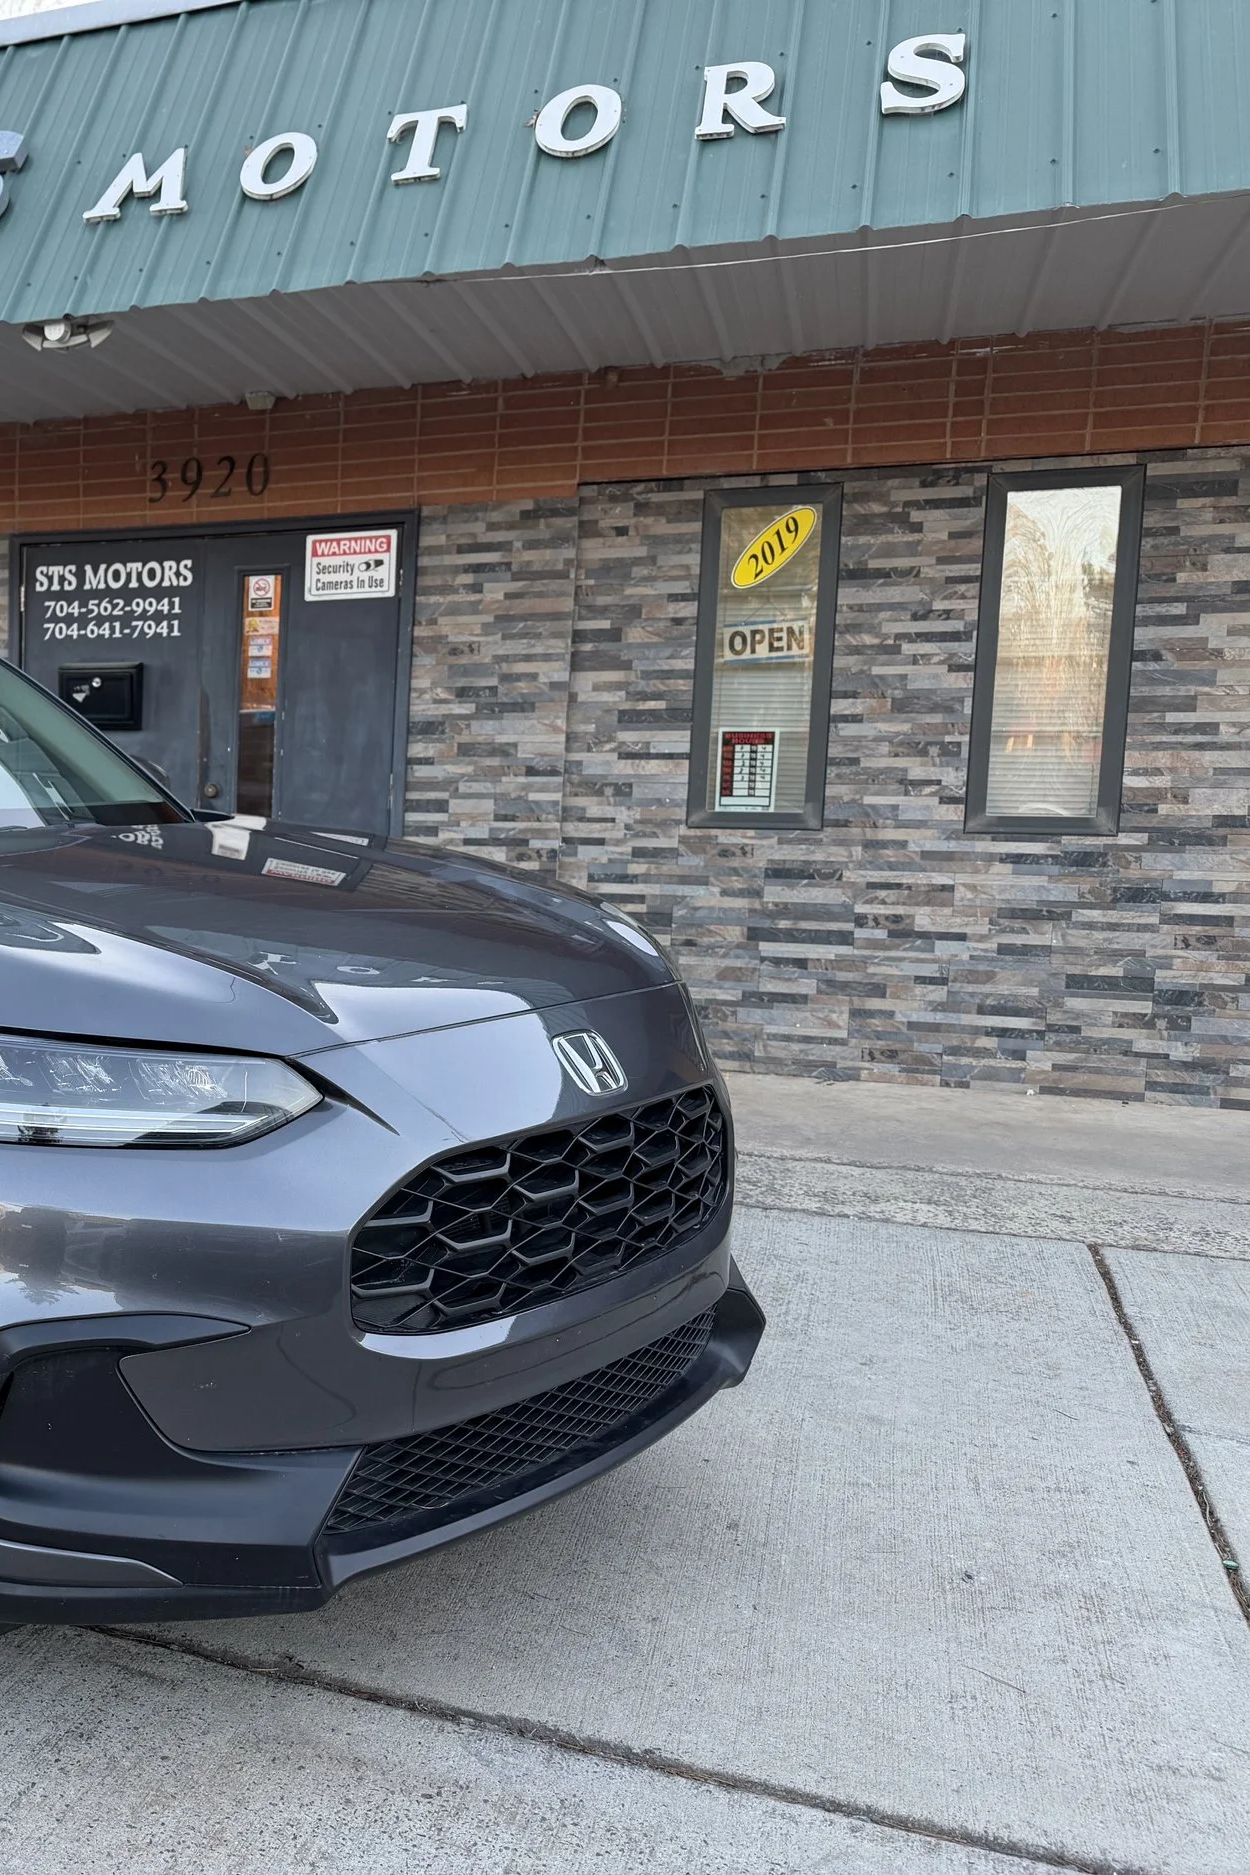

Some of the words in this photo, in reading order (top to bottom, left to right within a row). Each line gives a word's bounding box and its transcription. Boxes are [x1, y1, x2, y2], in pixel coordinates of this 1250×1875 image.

[83, 33, 967, 222] MOTORS
[148, 452, 269, 503] 3920
[315, 537, 387, 556] WARNING
[748, 516, 800, 580] 2019
[35, 564, 77, 592] STS
[83, 559, 193, 590] MOTORS
[316, 561, 355, 576] Security
[315, 579, 354, 591] Cameras
[356, 576, 365, 589] In
[368, 575, 384, 589] Use
[43, 597, 182, 619] 704-562-9941
[43, 620, 181, 641] 704-641-7941
[728, 625, 805, 656] OPEN
